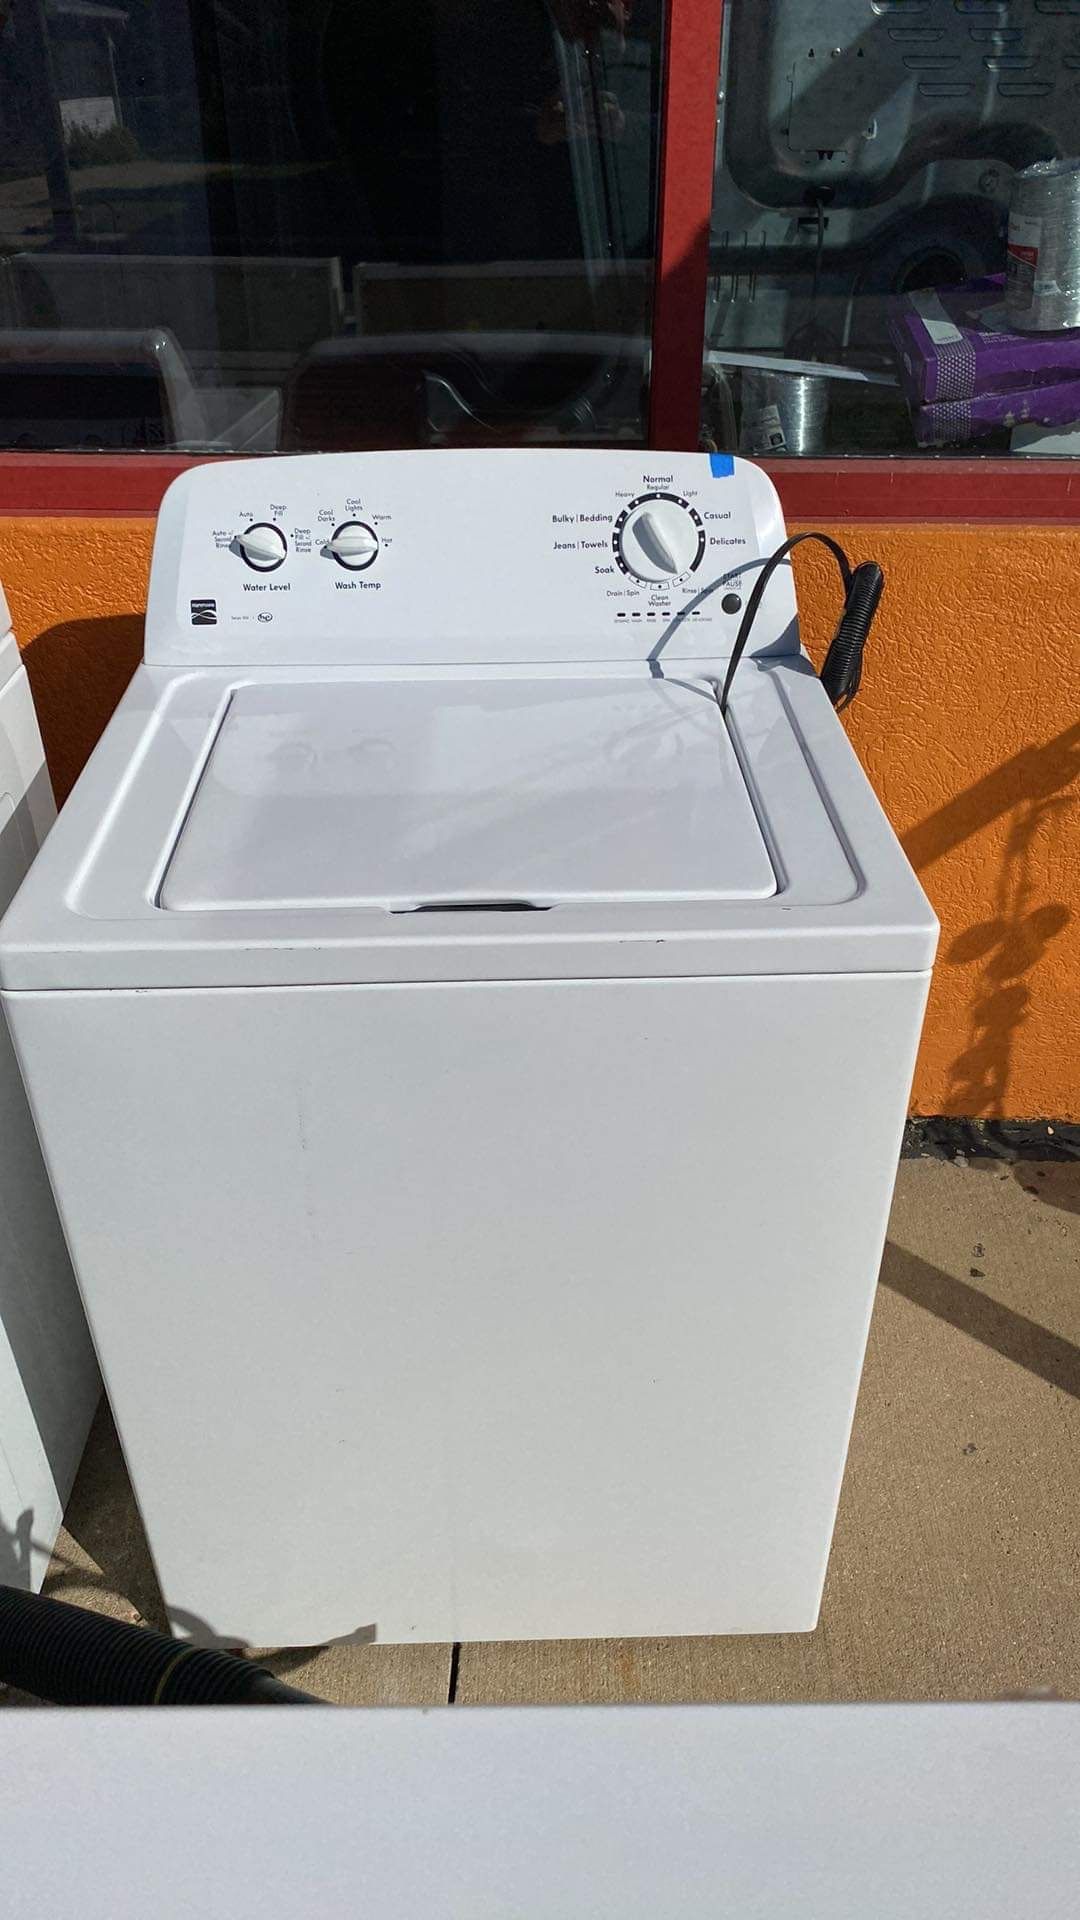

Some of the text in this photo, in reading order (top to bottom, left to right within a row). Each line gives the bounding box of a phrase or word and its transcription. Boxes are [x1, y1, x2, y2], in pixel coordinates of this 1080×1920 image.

[643, 475, 674, 484] Normal
[615, 491, 635, 499] Heavy
[552, 513, 613, 524] Bulky Bedding
[704, 511, 732, 521] Casual
[553, 540, 609, 550] Jeans Towels
[709, 537, 747, 546] Delicates
[594, 565, 616, 574] Soak
[243, 582, 291, 592] Water Level
[334, 580, 382, 592] Wash Temp
[626, 589, 640, 598] Spin
